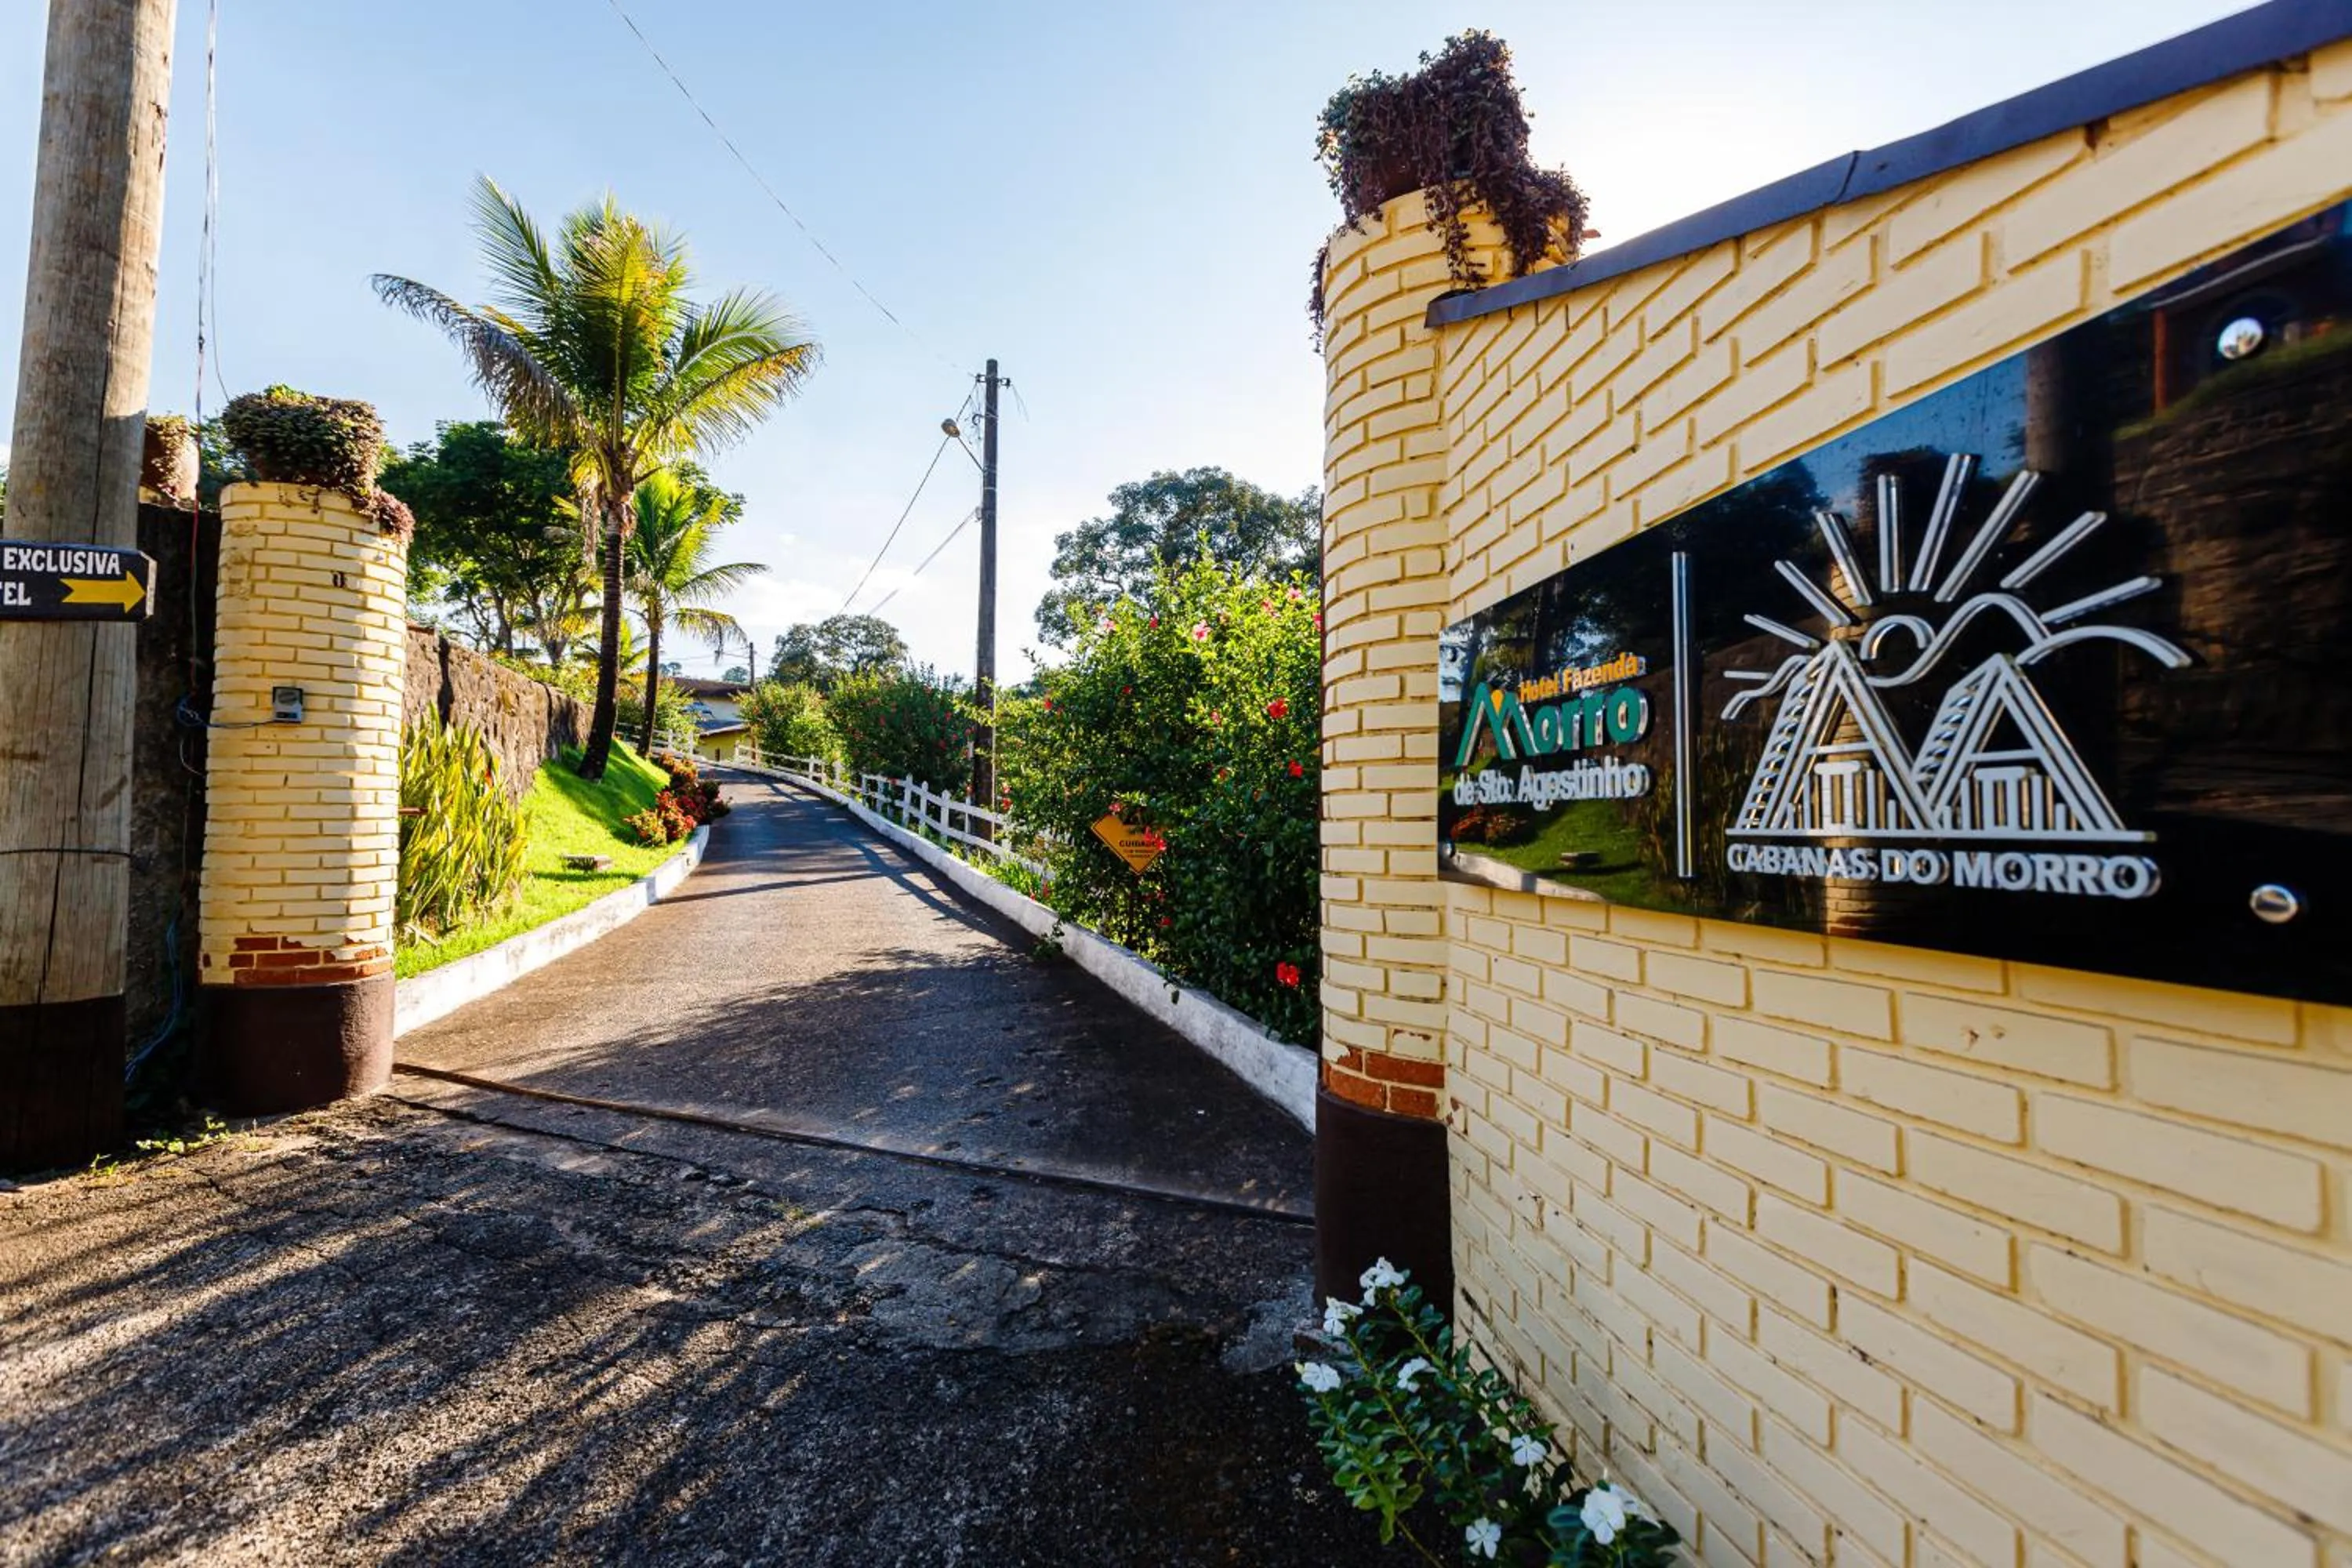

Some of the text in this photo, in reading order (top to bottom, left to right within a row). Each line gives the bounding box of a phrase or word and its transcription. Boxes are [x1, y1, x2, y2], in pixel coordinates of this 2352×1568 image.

[3, 546, 121, 575] EXCLUSIVA
[0, 581, 31, 605] EL
[1519, 652, 1641, 703] Hotel Fazenda
[1454, 681, 1646, 767] Morro
[1454, 772, 1475, 806] de
[1517, 756, 1645, 811] Agostinho
[1727, 843, 2158, 899] CABANAS DO MORRO
